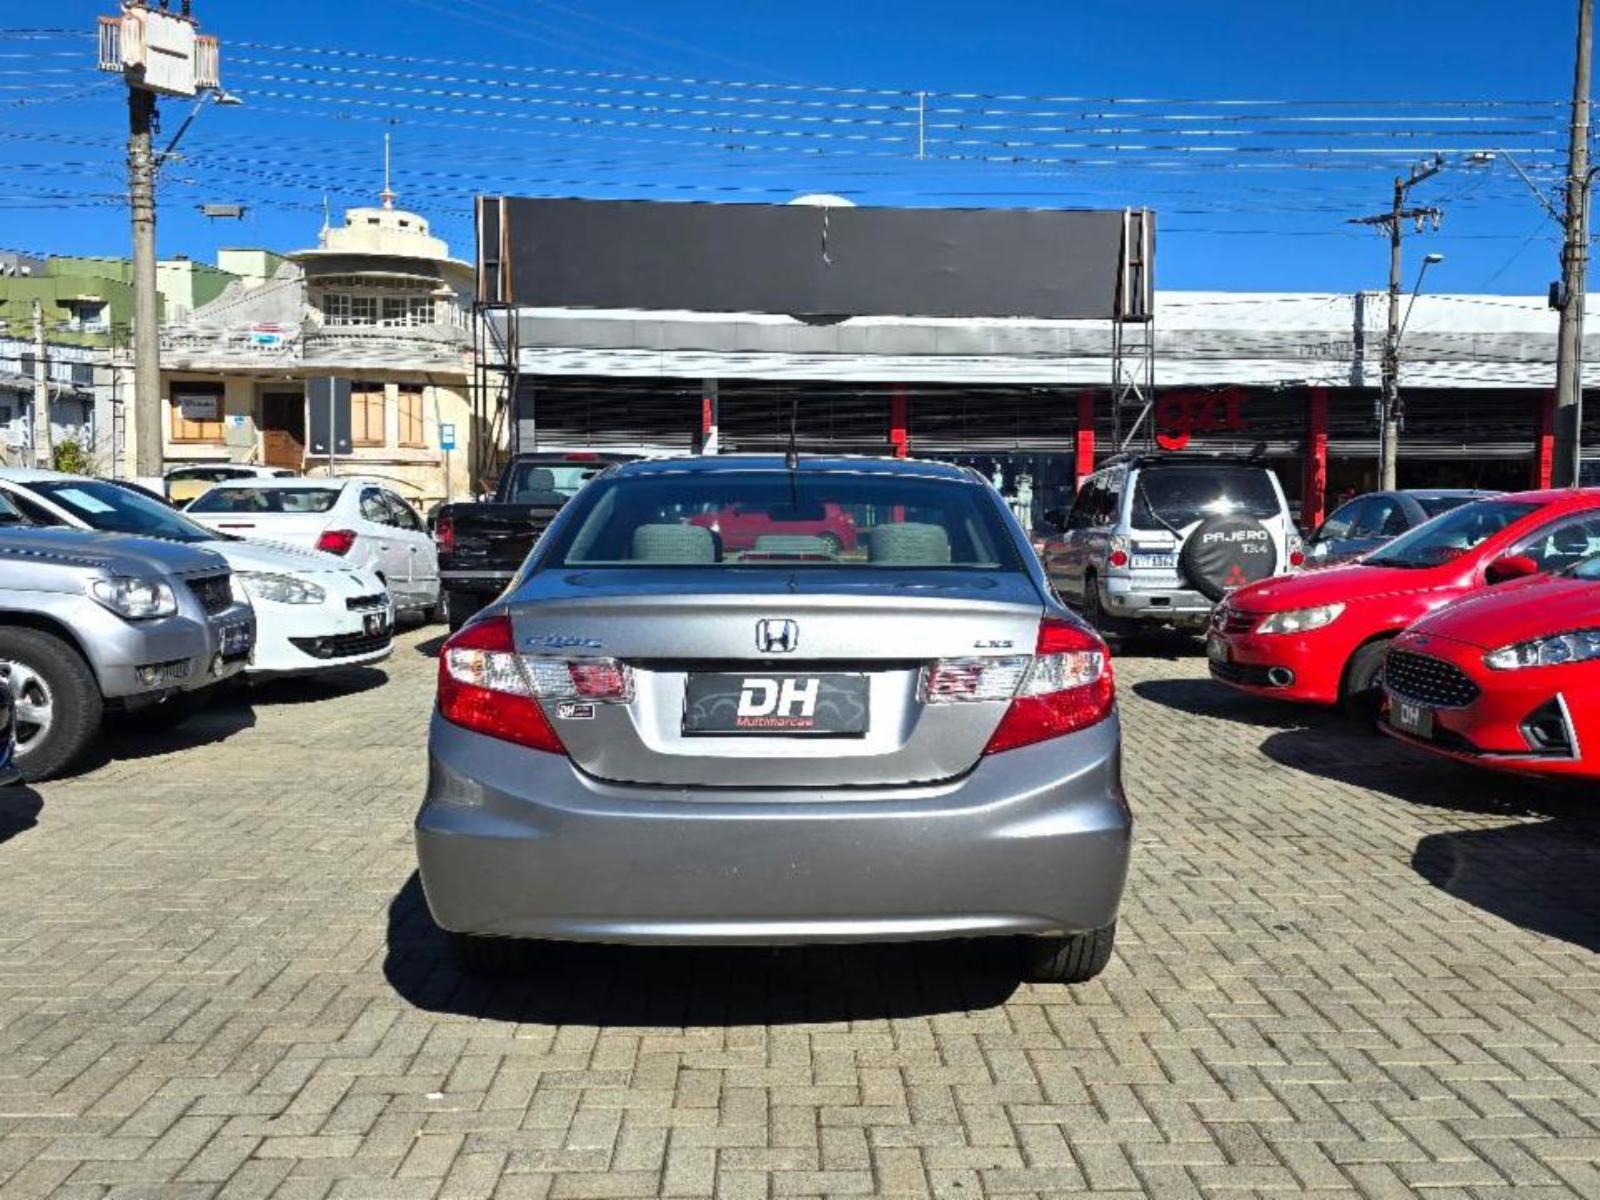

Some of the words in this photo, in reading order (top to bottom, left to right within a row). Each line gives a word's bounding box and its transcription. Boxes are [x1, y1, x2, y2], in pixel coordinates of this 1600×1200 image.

[1203, 530, 1268, 543] PAJERO
[736, 678, 820, 717] DH
[735, 717, 814, 728] Multimarcas
[1401, 703, 1419, 726] DH
